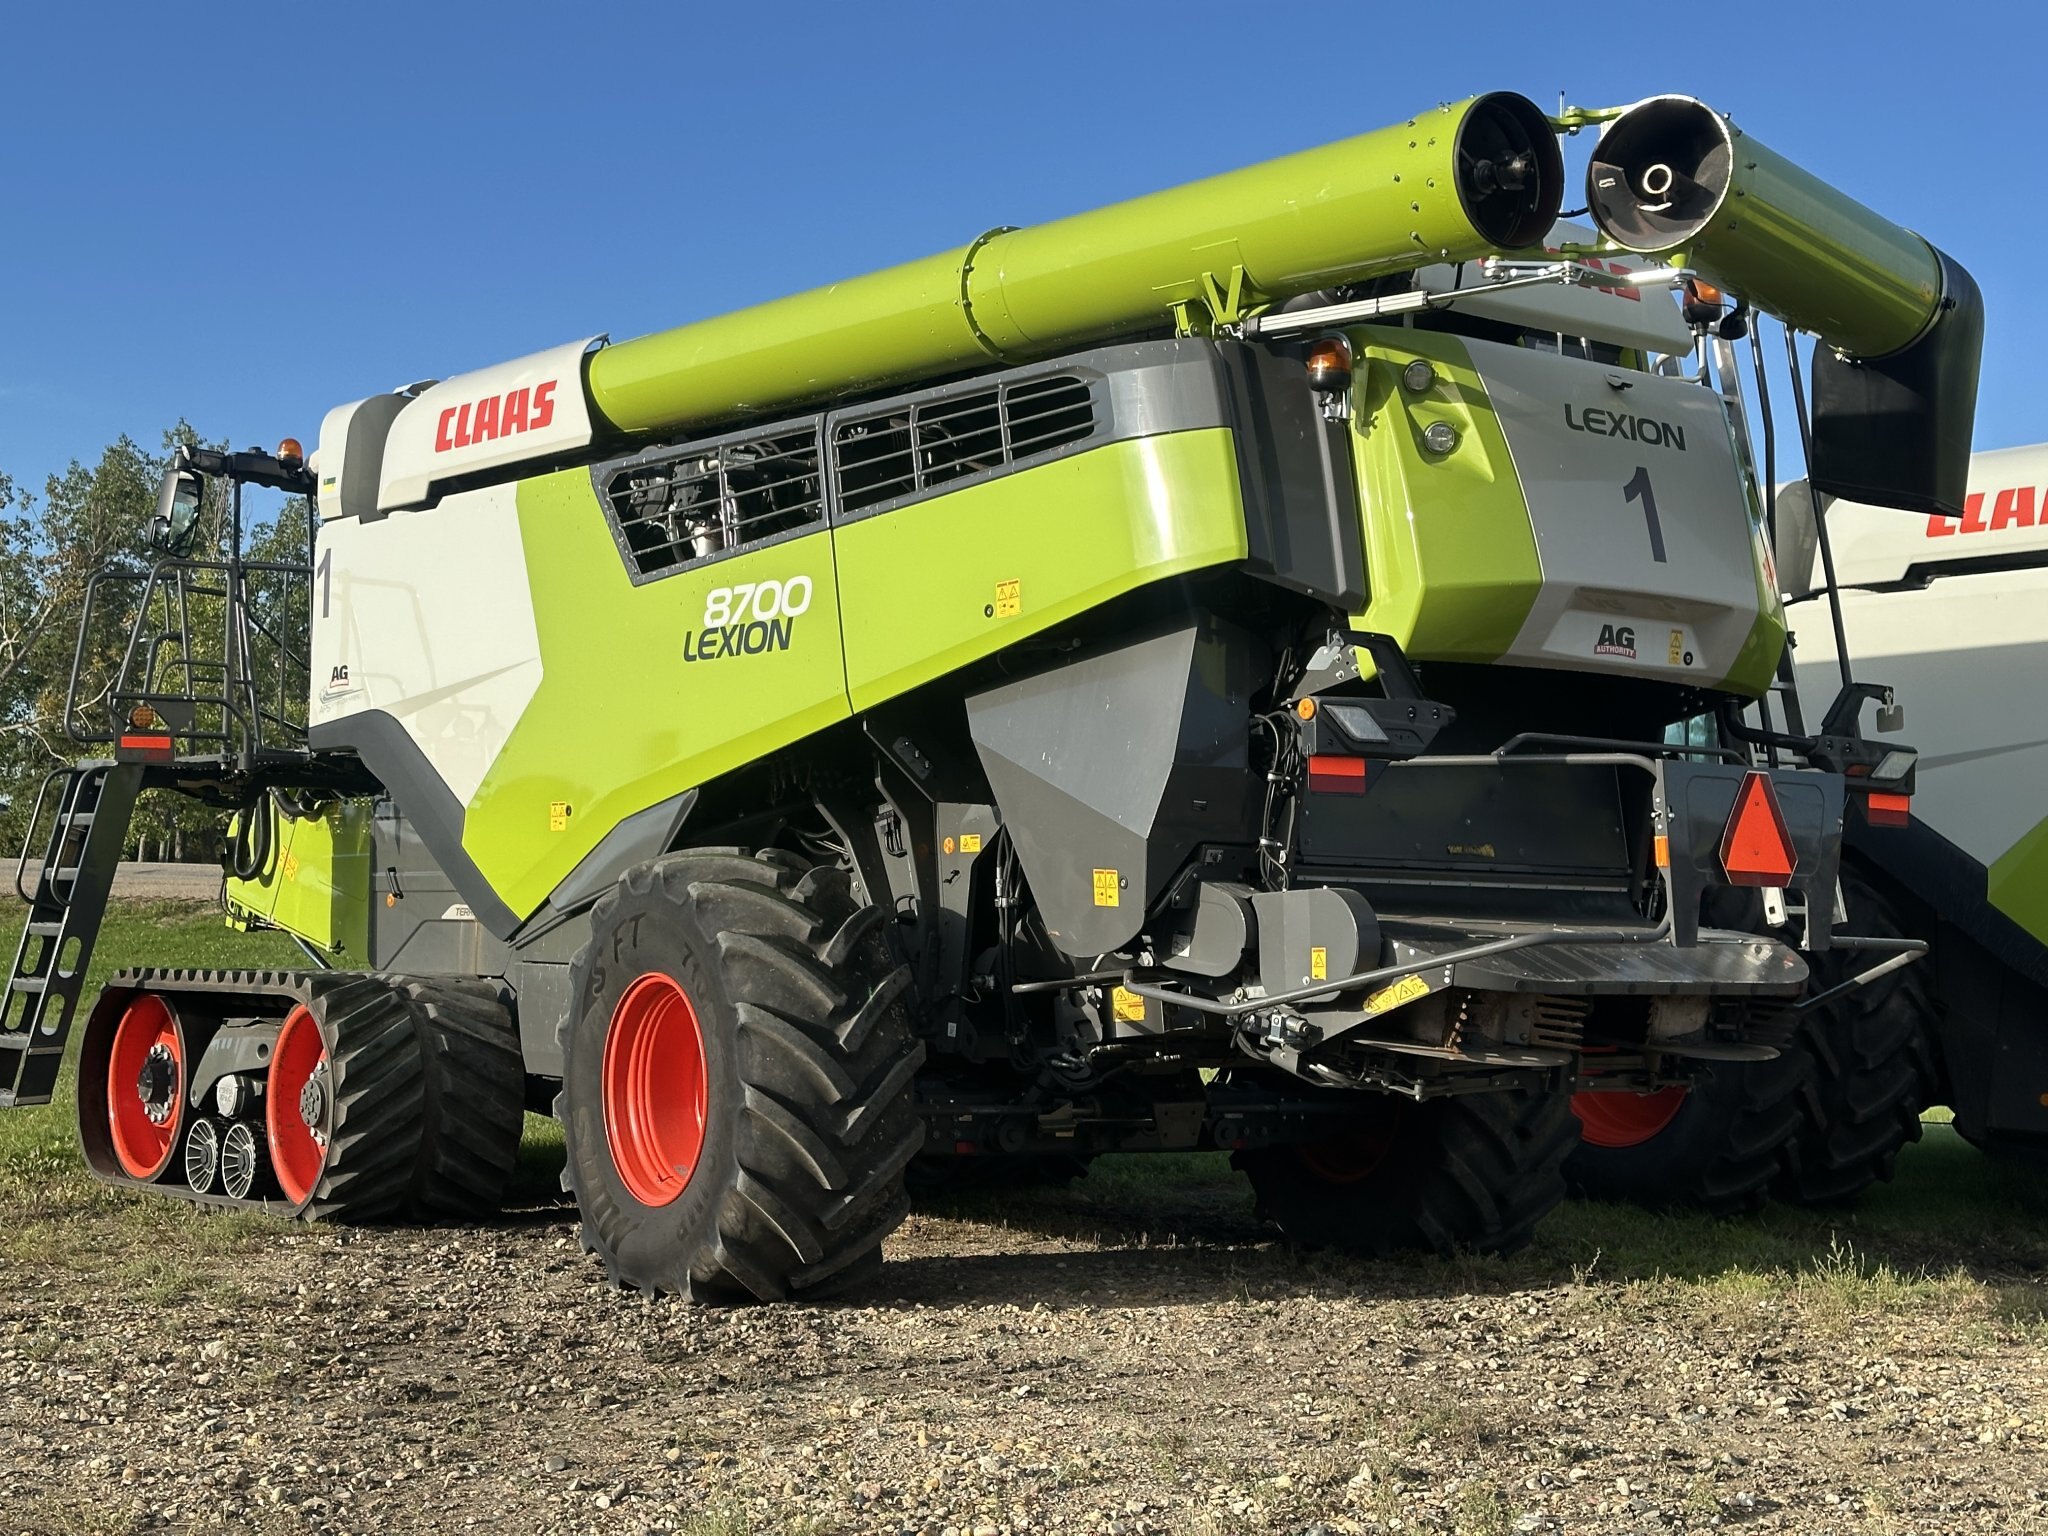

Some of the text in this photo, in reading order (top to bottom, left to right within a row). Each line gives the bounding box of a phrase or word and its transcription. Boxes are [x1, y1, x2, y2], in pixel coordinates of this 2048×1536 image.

[435, 380, 557, 453] CLAAS
[1564, 403, 1686, 452] LEXION
[1623, 466, 1667, 563] 1
[317, 548, 332, 619] 1
[703, 575, 813, 629] 8700
[683, 617, 794, 662] LEXION
[1596, 645, 1636, 658] AUTHORITY
[1597, 623, 1636, 650] AG
[331, 665, 348, 682] AG
